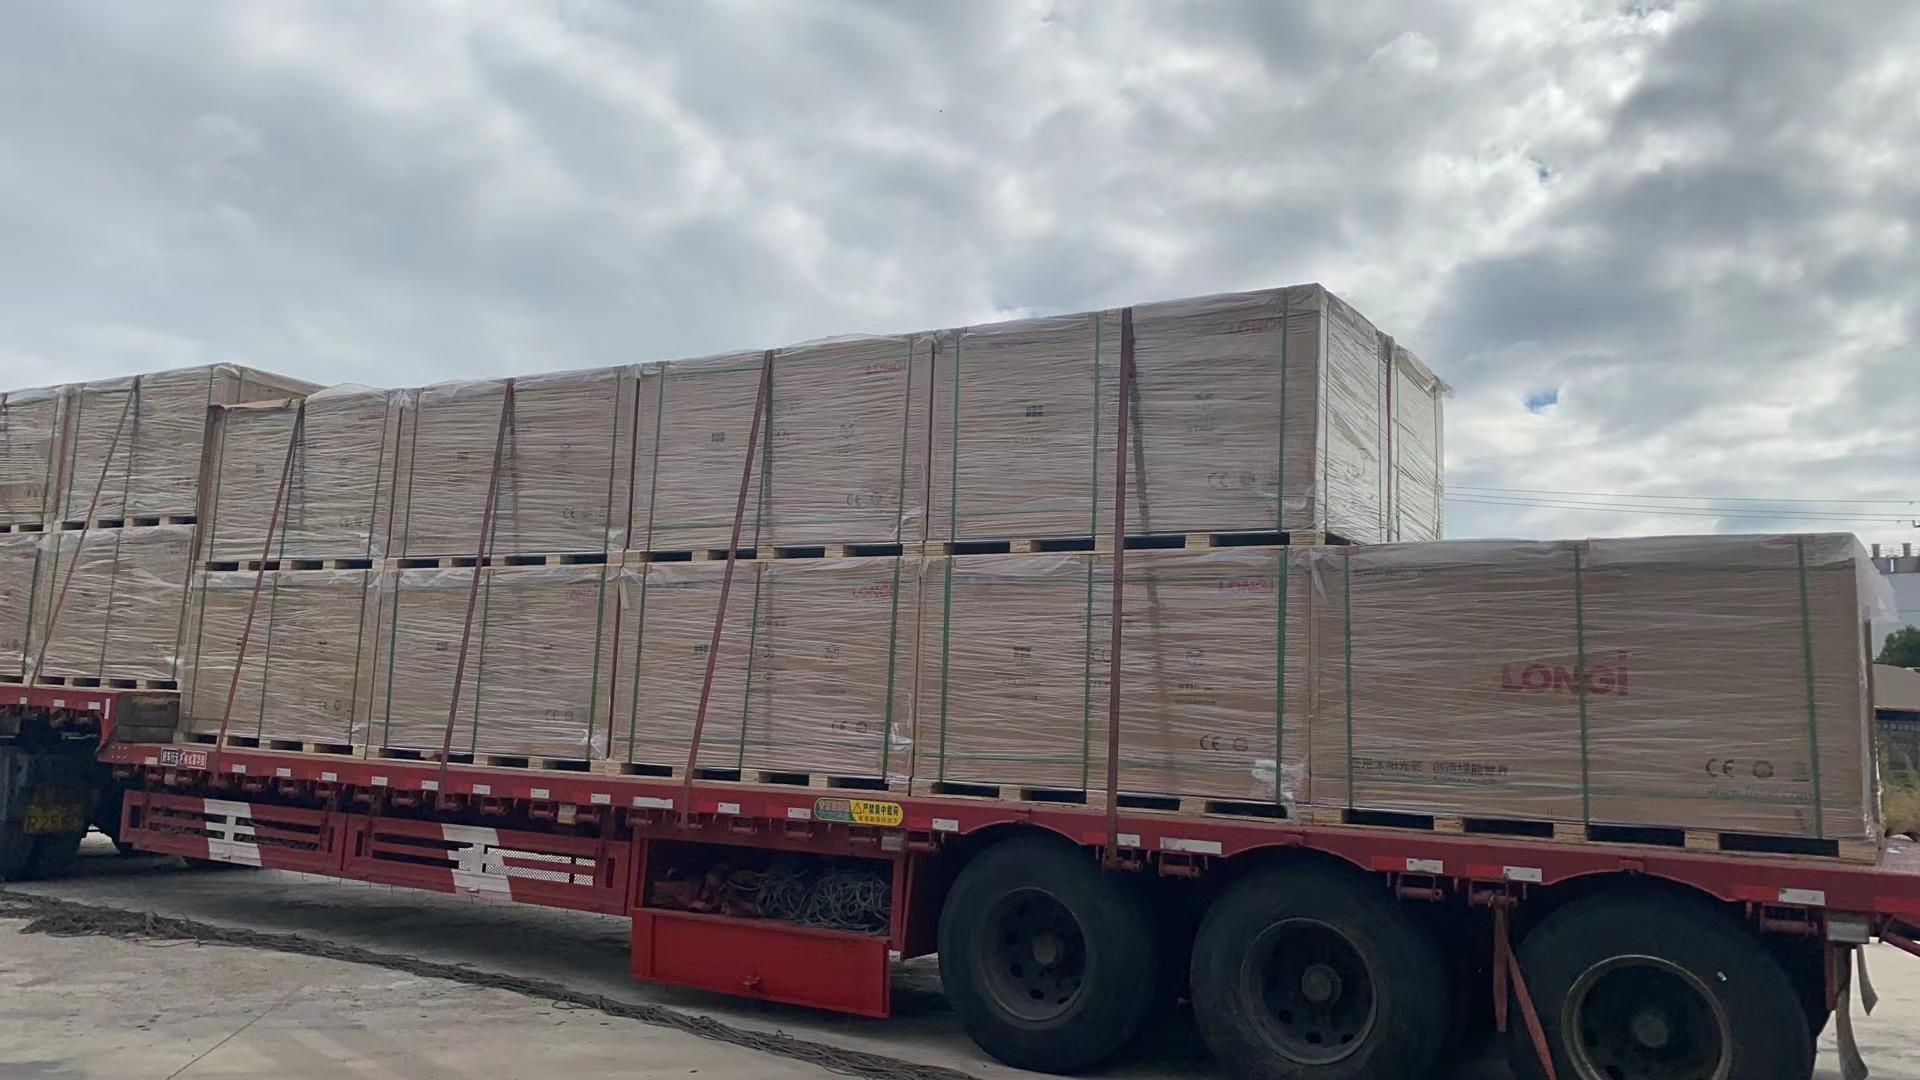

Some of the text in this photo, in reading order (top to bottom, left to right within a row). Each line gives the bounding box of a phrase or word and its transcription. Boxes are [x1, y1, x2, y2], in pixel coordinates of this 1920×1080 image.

[1503, 650, 1629, 697] LONGi
[1200, 734, 1222, 751] CE
[1704, 757, 1737, 777] CE
